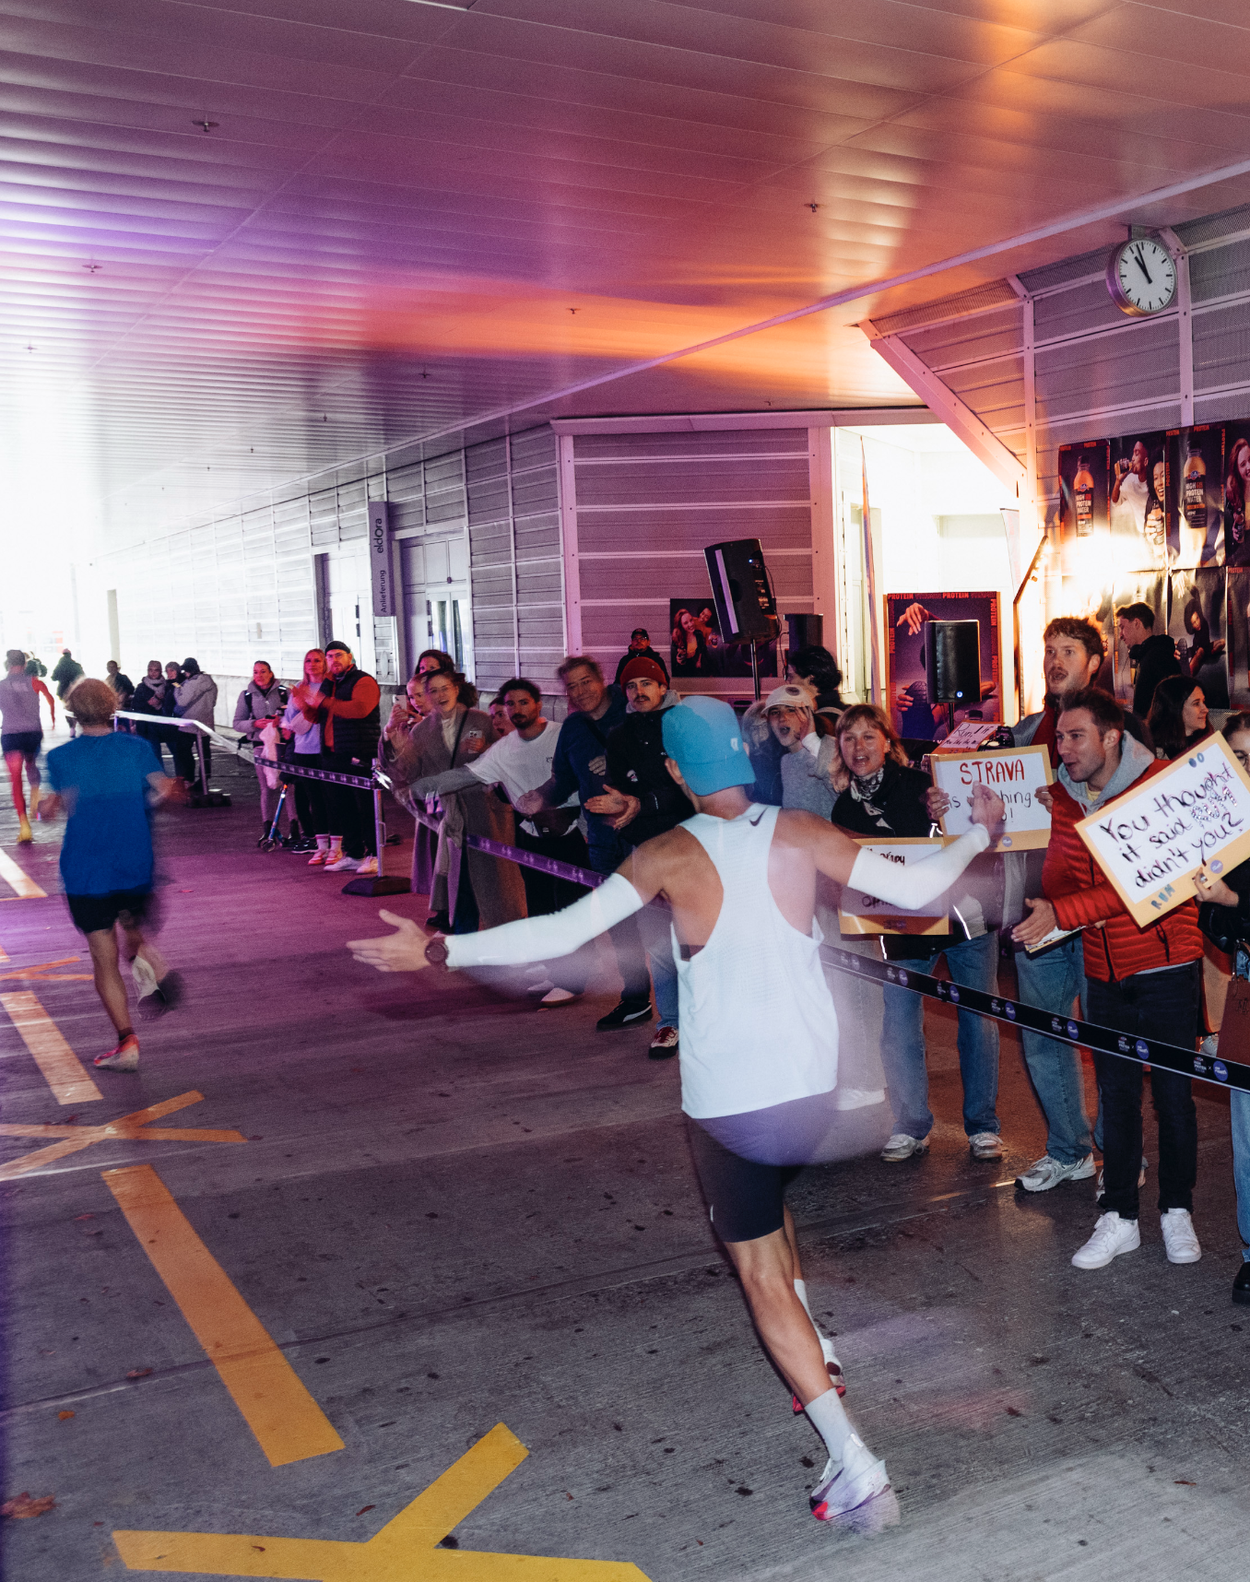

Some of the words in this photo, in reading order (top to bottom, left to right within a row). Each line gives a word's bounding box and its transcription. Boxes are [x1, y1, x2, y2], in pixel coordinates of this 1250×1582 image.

[960, 759, 1025, 785] STRAVA
[1099, 815, 1150, 843] You
[1154, 762, 1235, 817] thought
[1118, 843, 1142, 863] it
[1148, 817, 1193, 850] said
[1134, 846, 1191, 889] didn't
